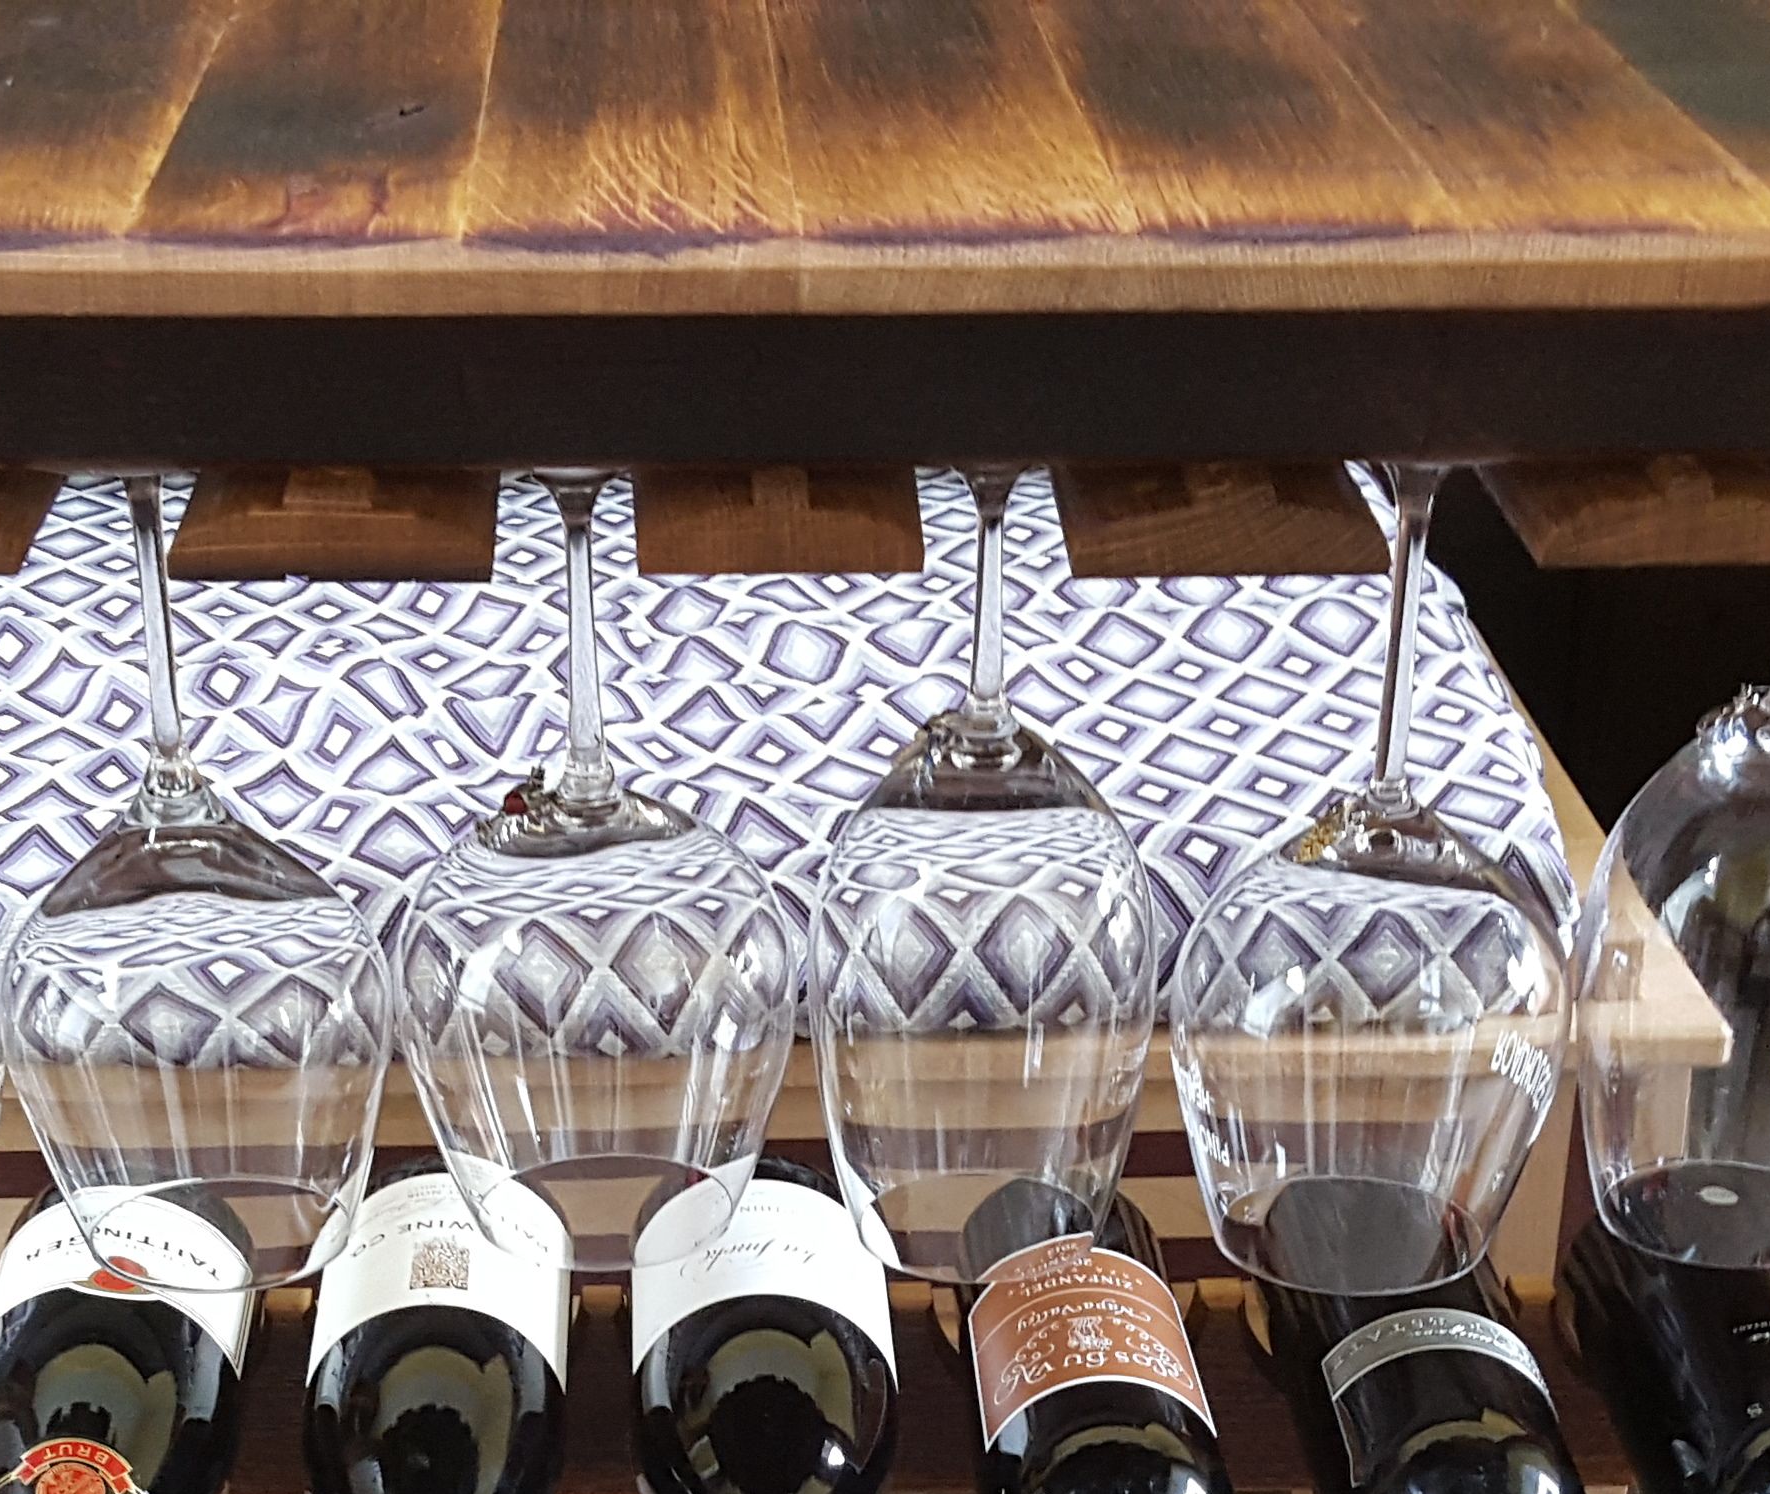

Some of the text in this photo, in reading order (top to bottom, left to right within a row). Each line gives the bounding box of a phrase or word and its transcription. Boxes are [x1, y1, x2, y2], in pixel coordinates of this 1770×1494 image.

[398, 1219, 474, 1235] WINE
[1020, 1273, 1136, 1297] ZINFANDEL
[43, 1444, 111, 1465] BRUT
